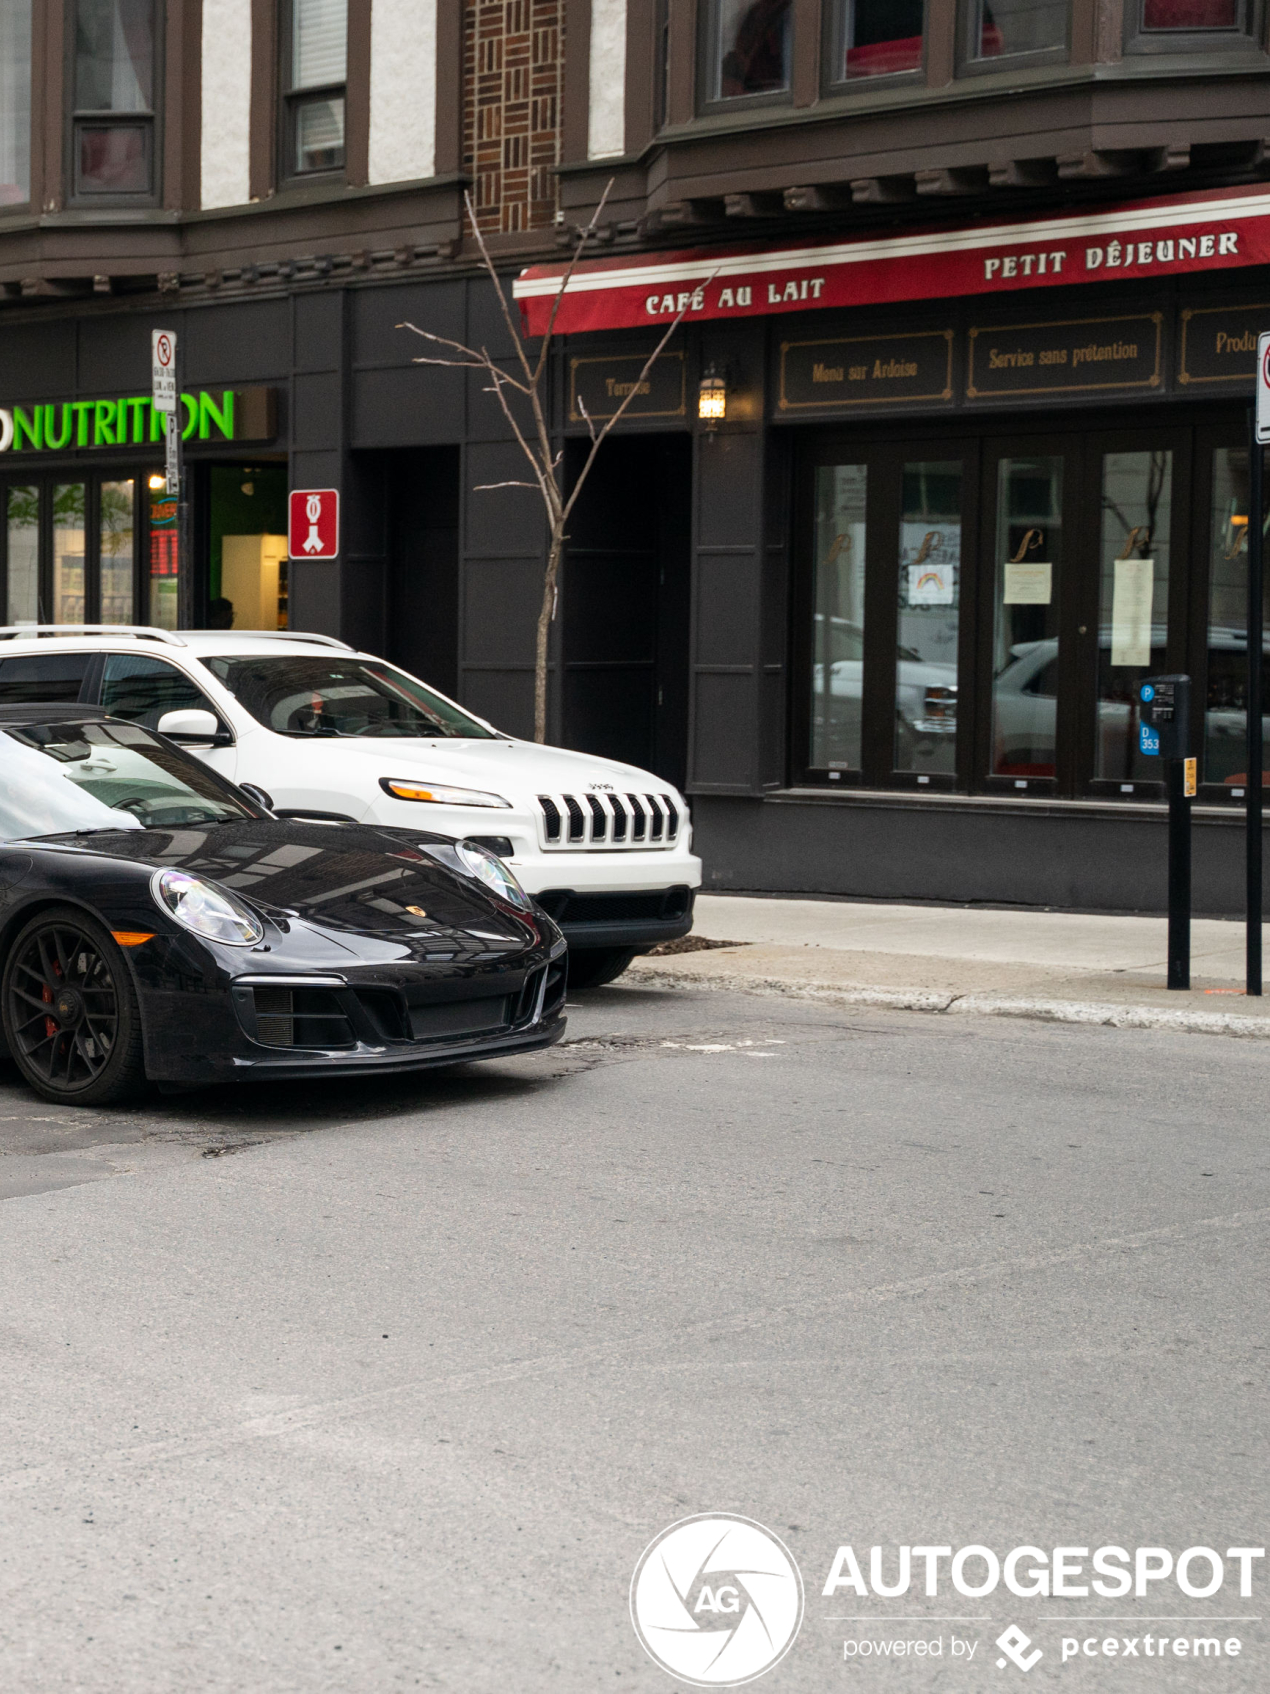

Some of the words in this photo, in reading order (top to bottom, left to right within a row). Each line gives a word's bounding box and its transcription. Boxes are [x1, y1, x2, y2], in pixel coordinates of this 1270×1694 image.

[984, 251, 1067, 280] PETIT
[645, 289, 704, 315] CAFÉ
[718, 286, 751, 308] AU
[768, 278, 826, 304] LAIT
[1216, 330, 1261, 354] Produ
[989, 349, 1034, 369] Service
[1038, 350, 1068, 365] sans
[1073, 341, 1138, 368] prétention
[848, 366, 869, 381] sur
[872, 358, 918, 379] Ardoise
[1142, 727, 1149, 738] D
[1142, 738, 1159, 750] 353
